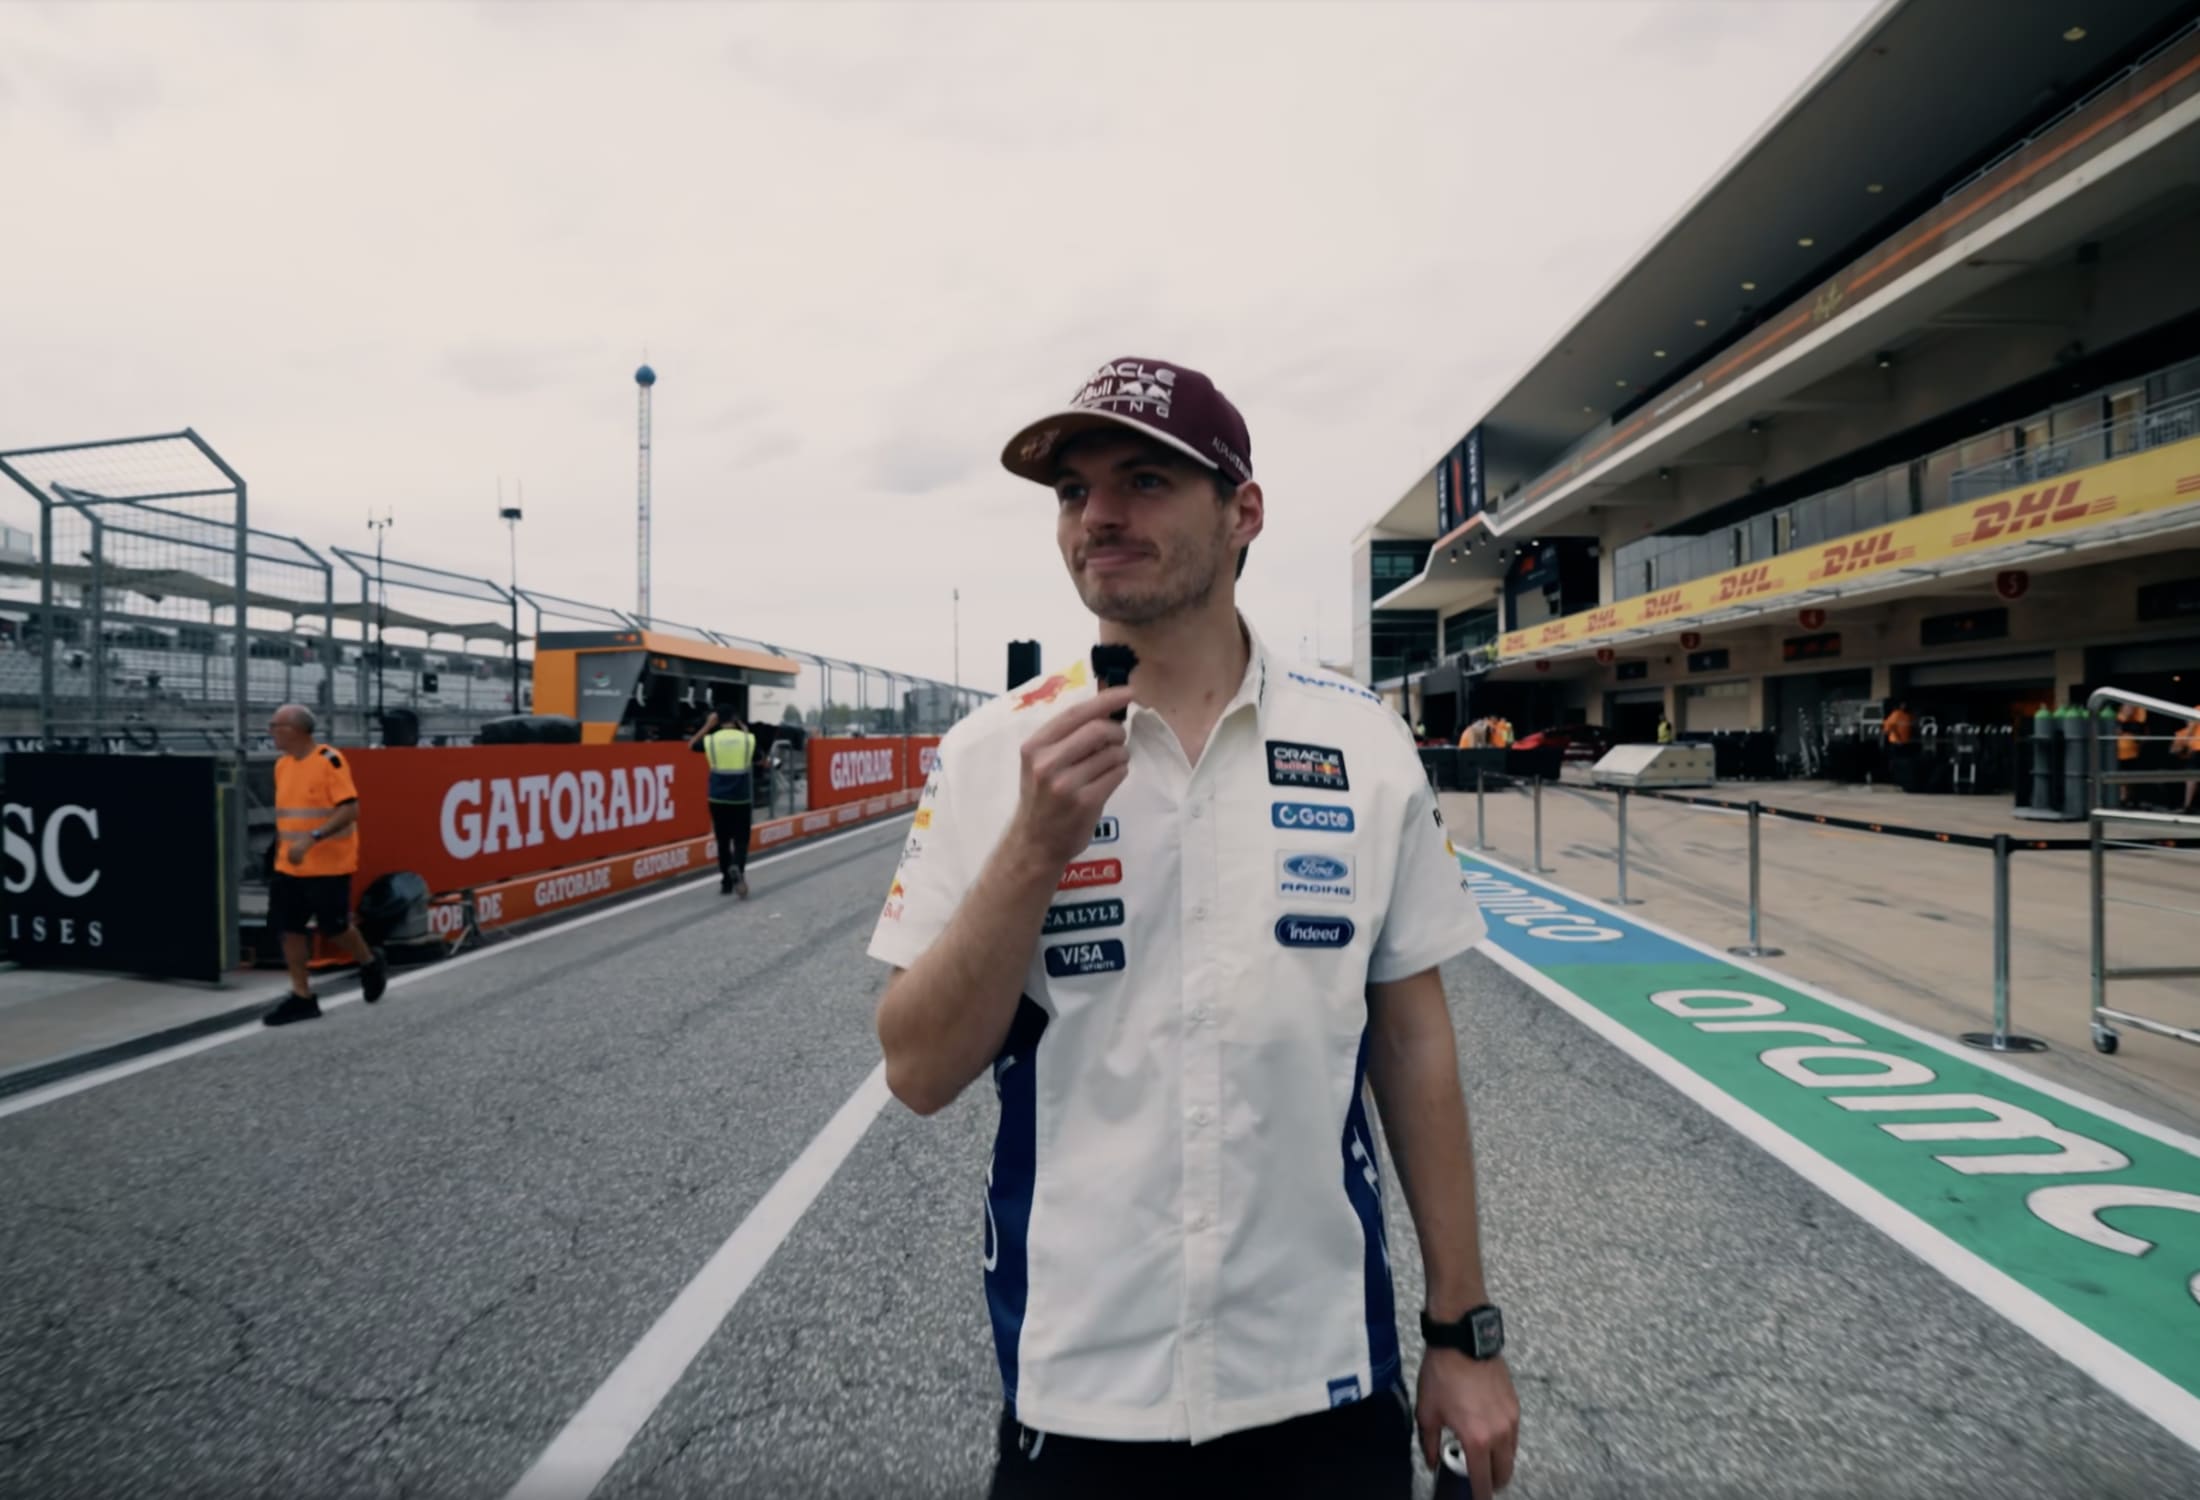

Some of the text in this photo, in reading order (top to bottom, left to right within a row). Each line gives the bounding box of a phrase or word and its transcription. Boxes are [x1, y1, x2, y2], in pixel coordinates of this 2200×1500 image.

[1971, 480, 2090, 542] DHL
[1822, 532, 1897, 577] DHL
[1720, 566, 1771, 600] DHL
[1644, 590, 1683, 618] DHL
[831, 749, 893, 791] GATORADE
[1274, 747, 1339, 765] ORACLE
[440, 764, 675, 860] GATORADE
[1299, 807, 1348, 828] Gate
[633, 847, 689, 880] GATORADE
[1298, 857, 1335, 877] Ford
[534, 866, 611, 906] GATORADE
[1061, 944, 1104, 966] VISA
[1649, 989, 2200, 1307] aramc
